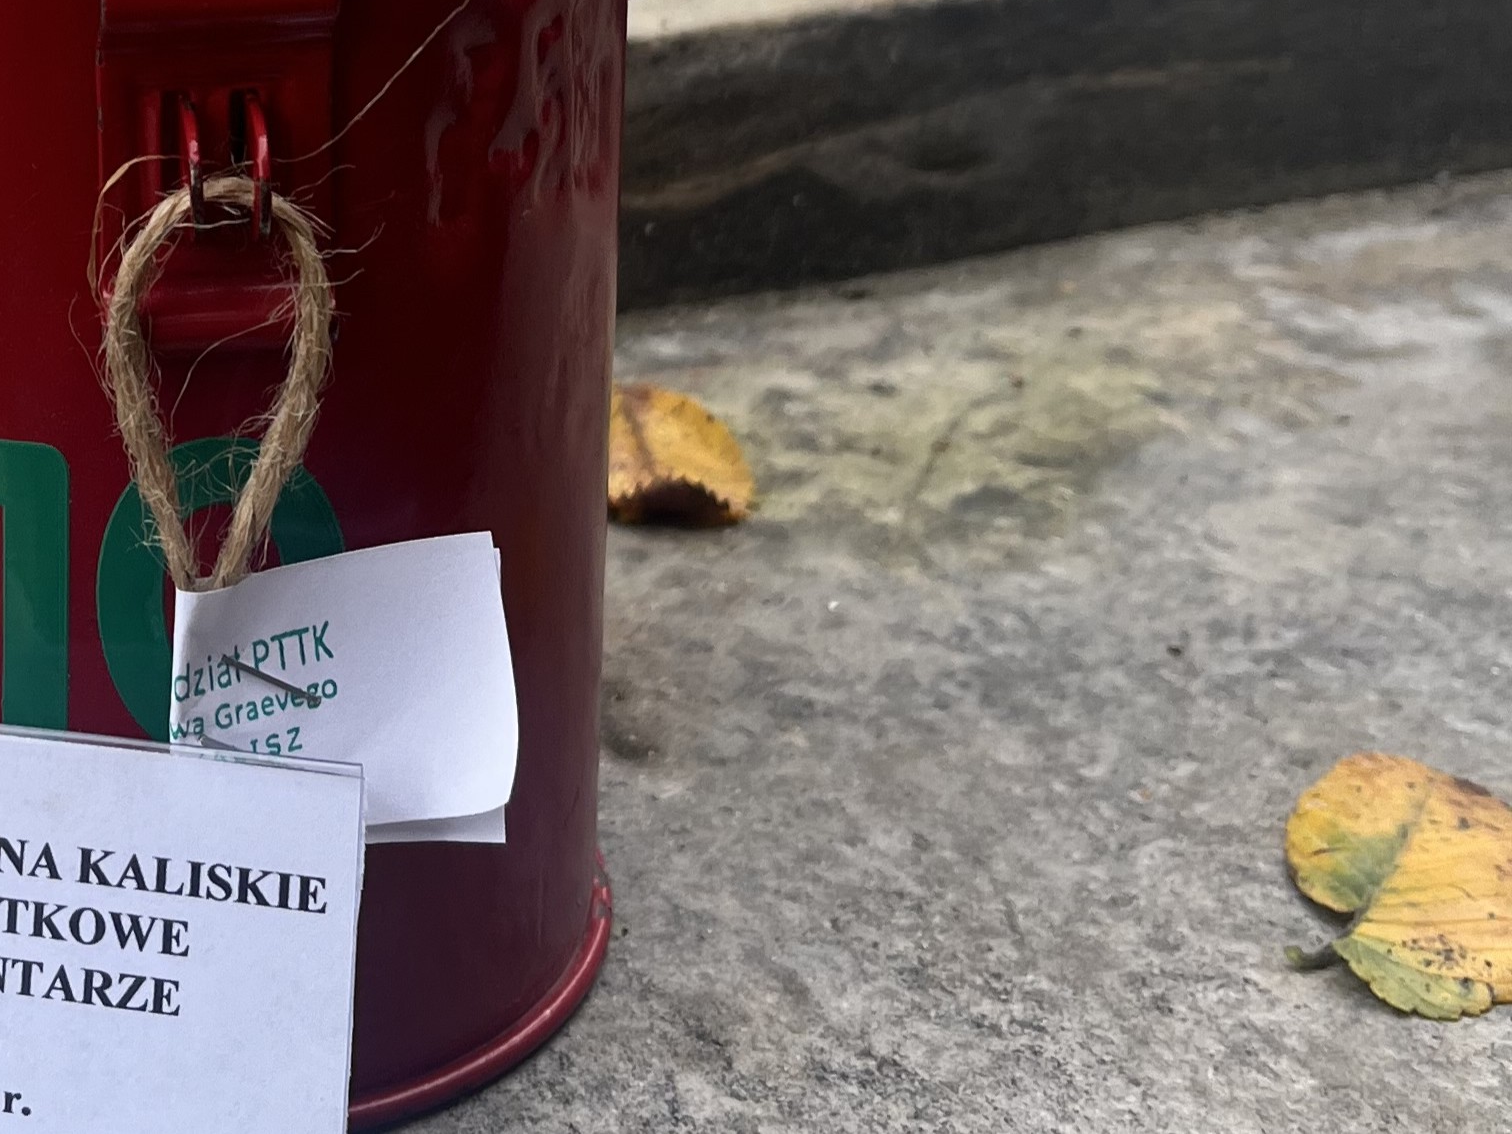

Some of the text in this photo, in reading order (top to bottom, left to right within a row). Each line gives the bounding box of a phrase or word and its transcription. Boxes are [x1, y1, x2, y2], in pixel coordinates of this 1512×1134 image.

[252, 620, 334, 672] PTTK
[75, 846, 327, 914] KALISKIE
[1, 1091, 32, 1116] r.
